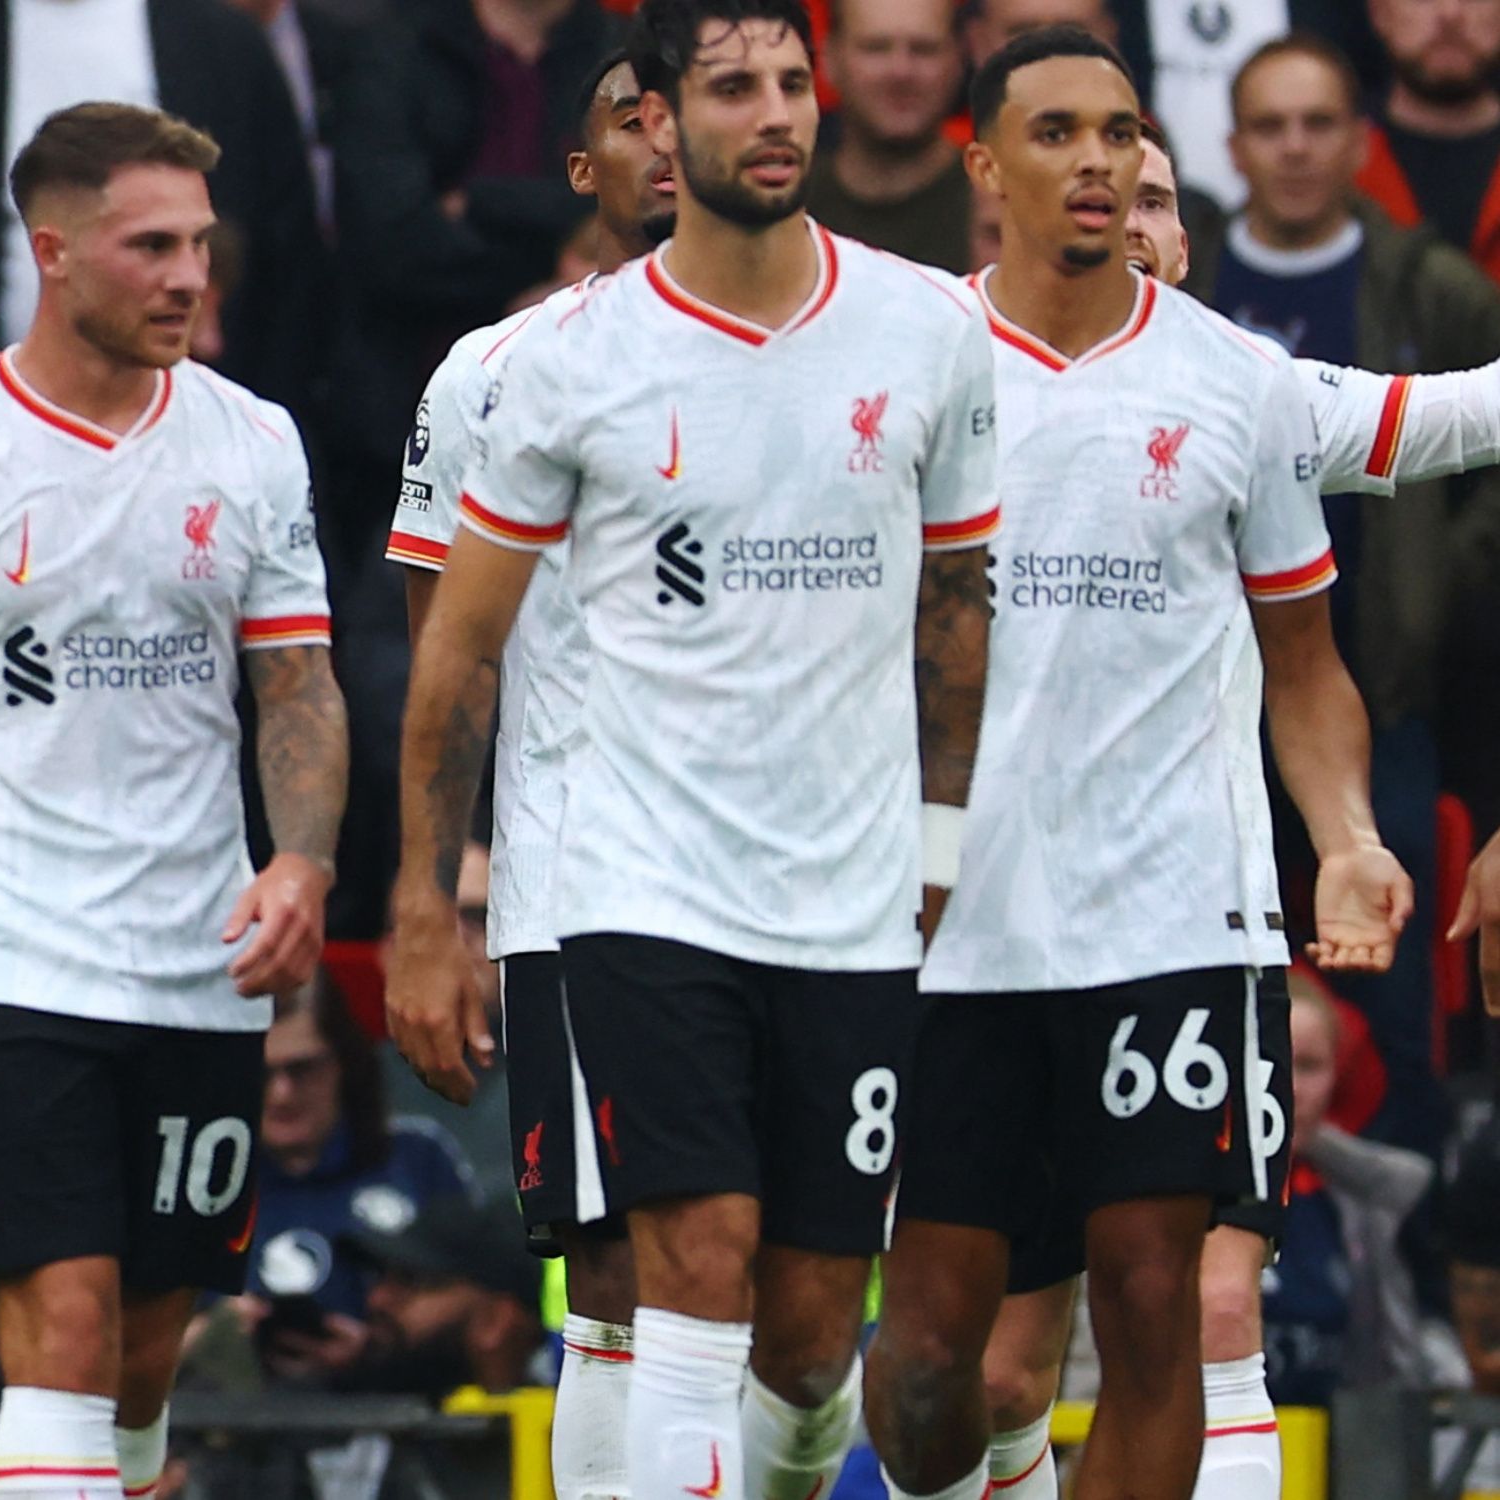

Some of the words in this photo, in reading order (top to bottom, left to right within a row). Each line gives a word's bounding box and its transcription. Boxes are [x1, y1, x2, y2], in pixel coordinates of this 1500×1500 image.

[721, 533, 877, 563] standard
[722, 563, 883, 592] chartered
[1011, 552, 1162, 584] standard
[1011, 581, 1167, 614] chartered
[63, 629, 209, 661] standard
[66, 657, 216, 690] chartered
[1101, 1008, 1229, 1119] 66
[845, 1066, 898, 1175] 8
[153, 1115, 251, 1217] 10
